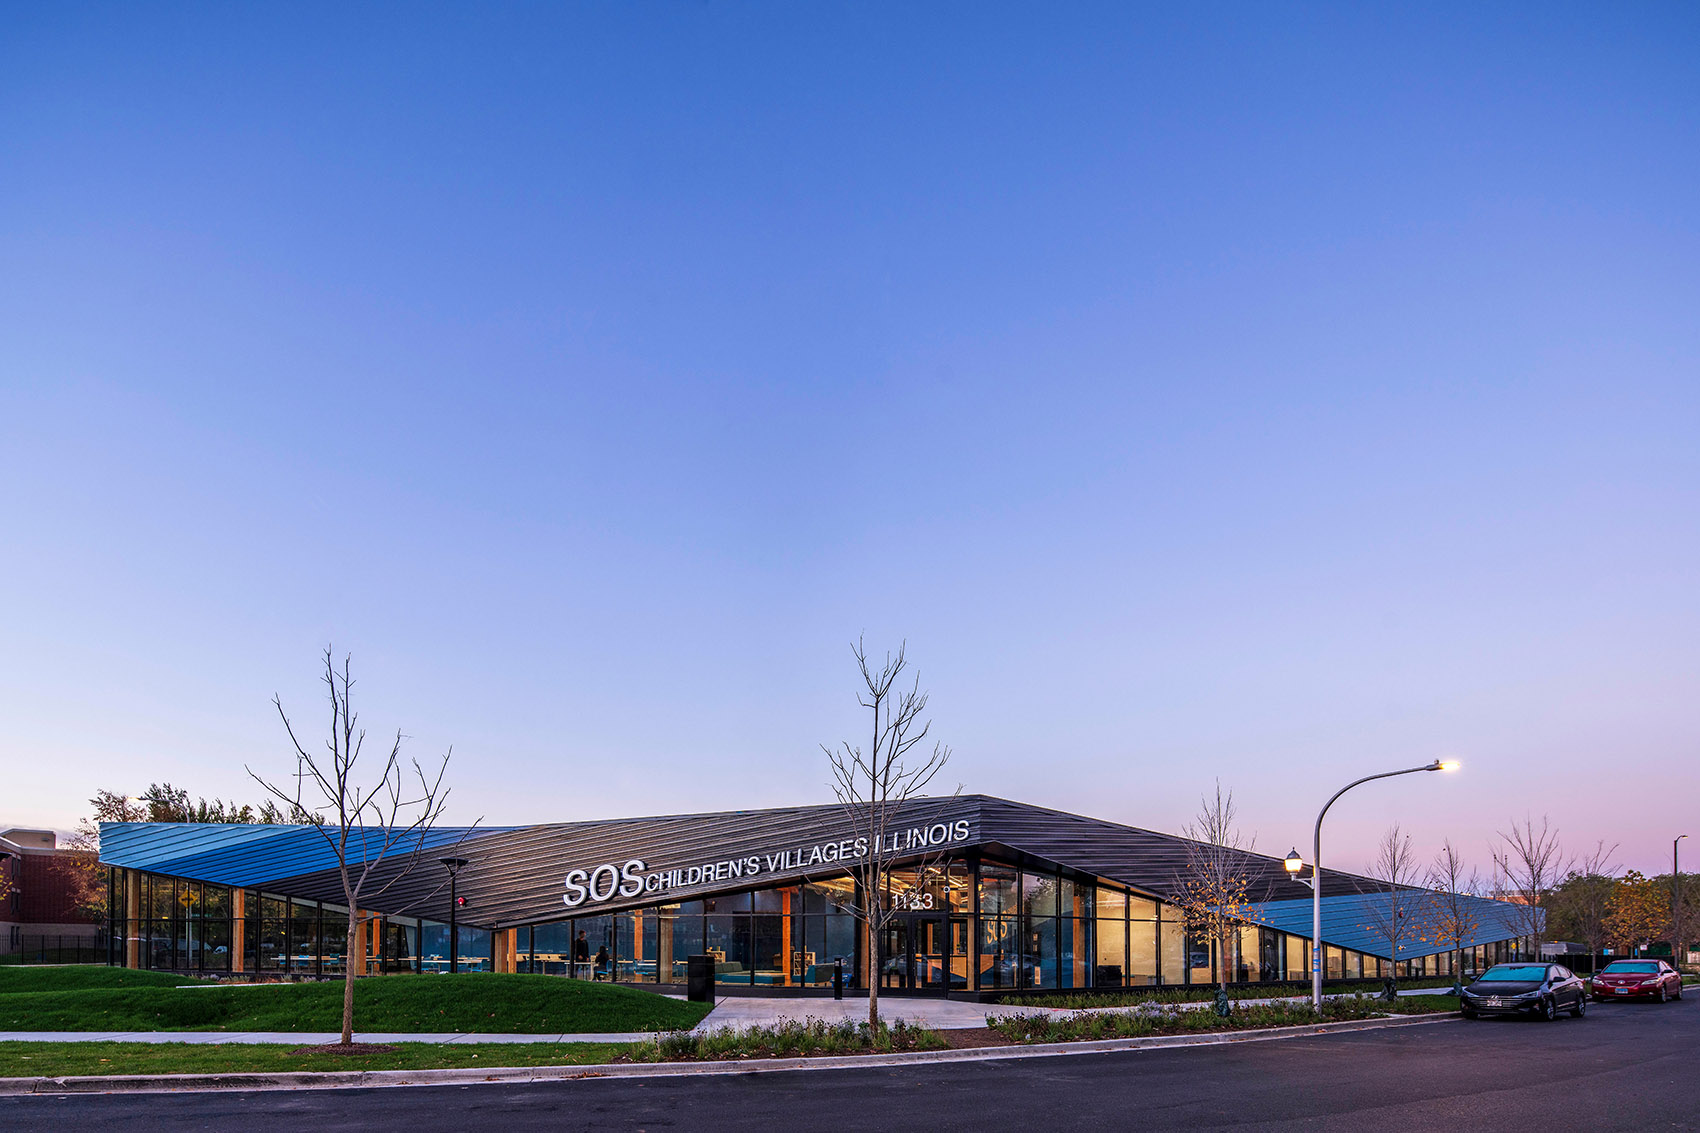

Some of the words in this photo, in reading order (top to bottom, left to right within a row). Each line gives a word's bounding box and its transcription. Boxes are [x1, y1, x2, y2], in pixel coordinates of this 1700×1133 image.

[563, 859, 646, 906] SOS
[645, 855, 760, 892] CHILDREN'S
[765, 836, 868, 872] VILLAGES
[874, 820, 970, 854] ILLINOIS
